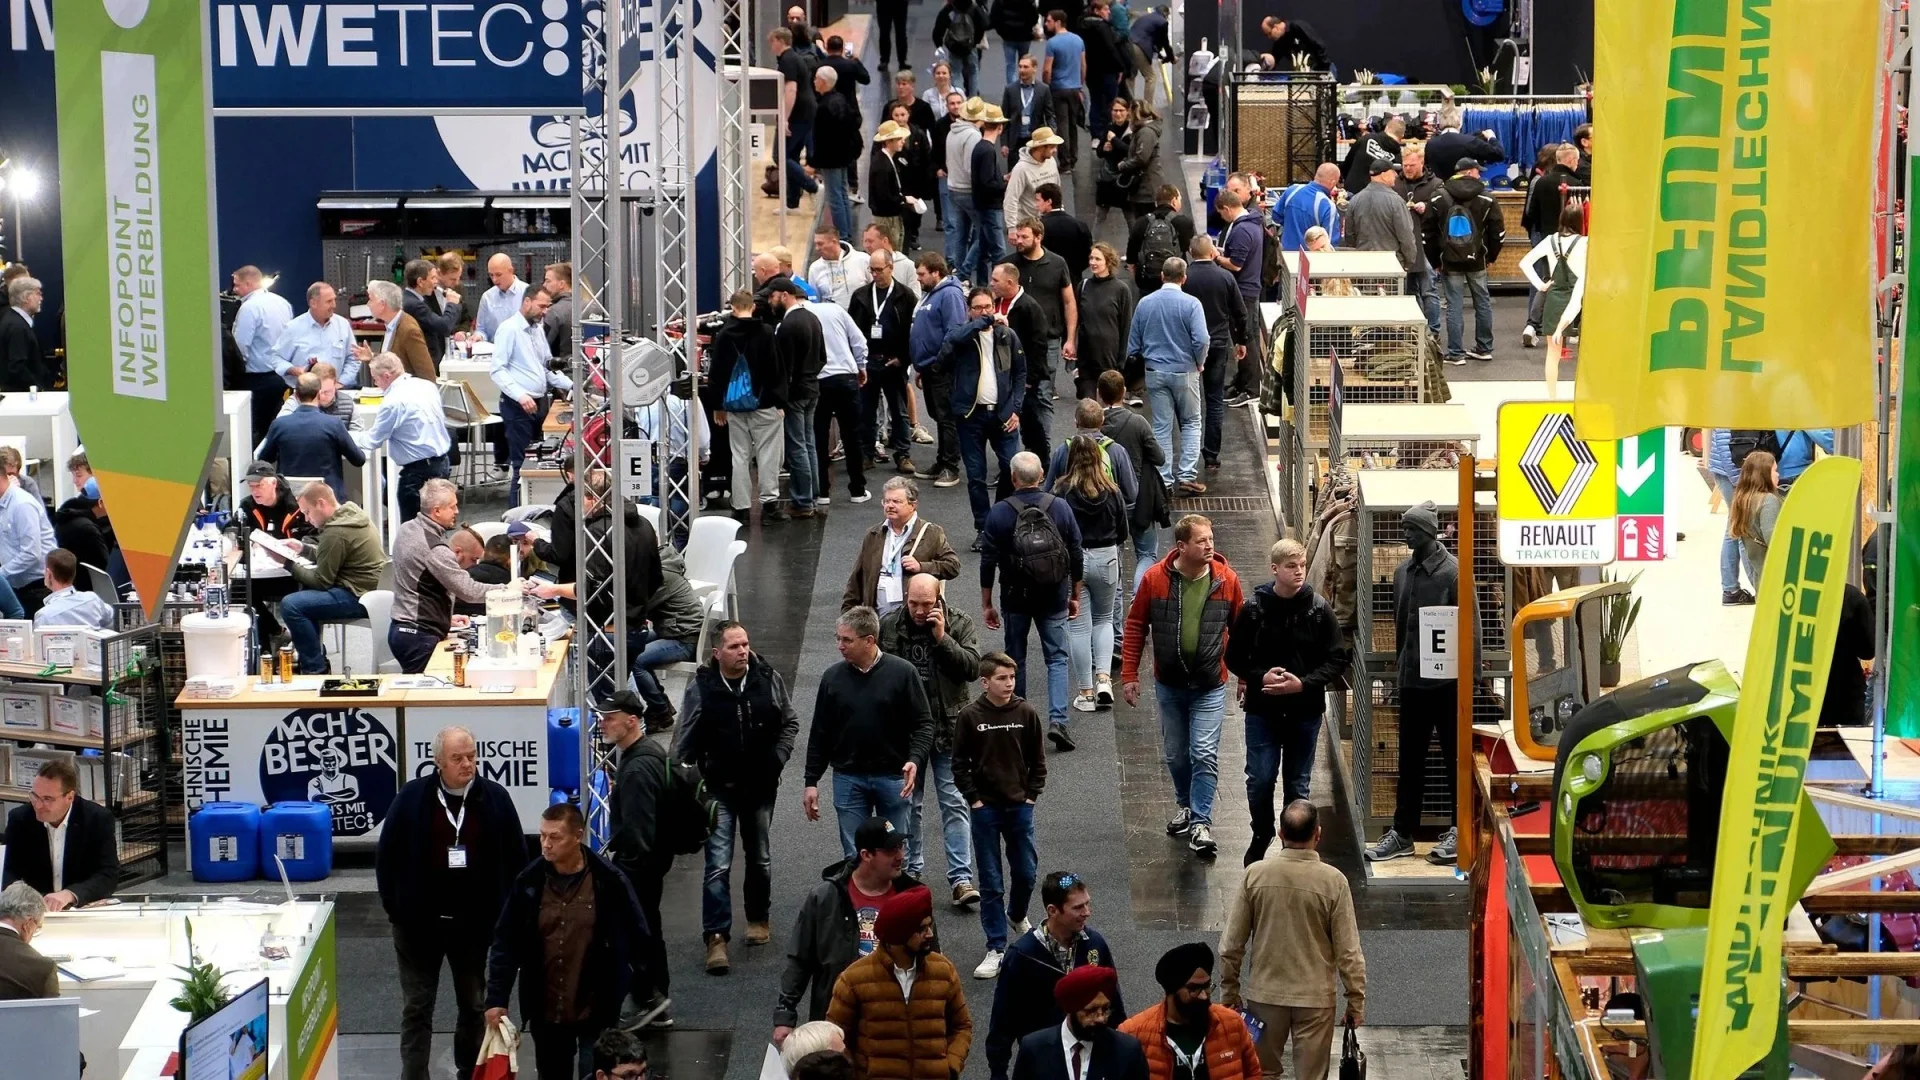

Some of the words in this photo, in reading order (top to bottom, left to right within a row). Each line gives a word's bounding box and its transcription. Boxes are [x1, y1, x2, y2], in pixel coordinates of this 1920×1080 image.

[218, 3, 535, 67] IWETEC
[751, 135, 759, 148] E
[132, 94, 159, 386] WEITERBILDUNG
[114, 195, 137, 384] INFOPOINT
[631, 457, 641, 476] E
[1520, 524, 1597, 546] RENAULT
[1516, 549, 1600, 560] TRAKTOREN
[1432, 629, 1446, 653] E
[1434, 663, 1444, 671] 41
[977, 722, 1024, 732] Champion
[203, 718, 231, 803] HEMIE
[265, 733, 397, 775] BESSER
[415, 741, 538, 759] TEISCHE
[185, 719, 203, 812] CHNISCHE
[416, 760, 538, 787] CMIE
[346, 802, 366, 813] MIT
